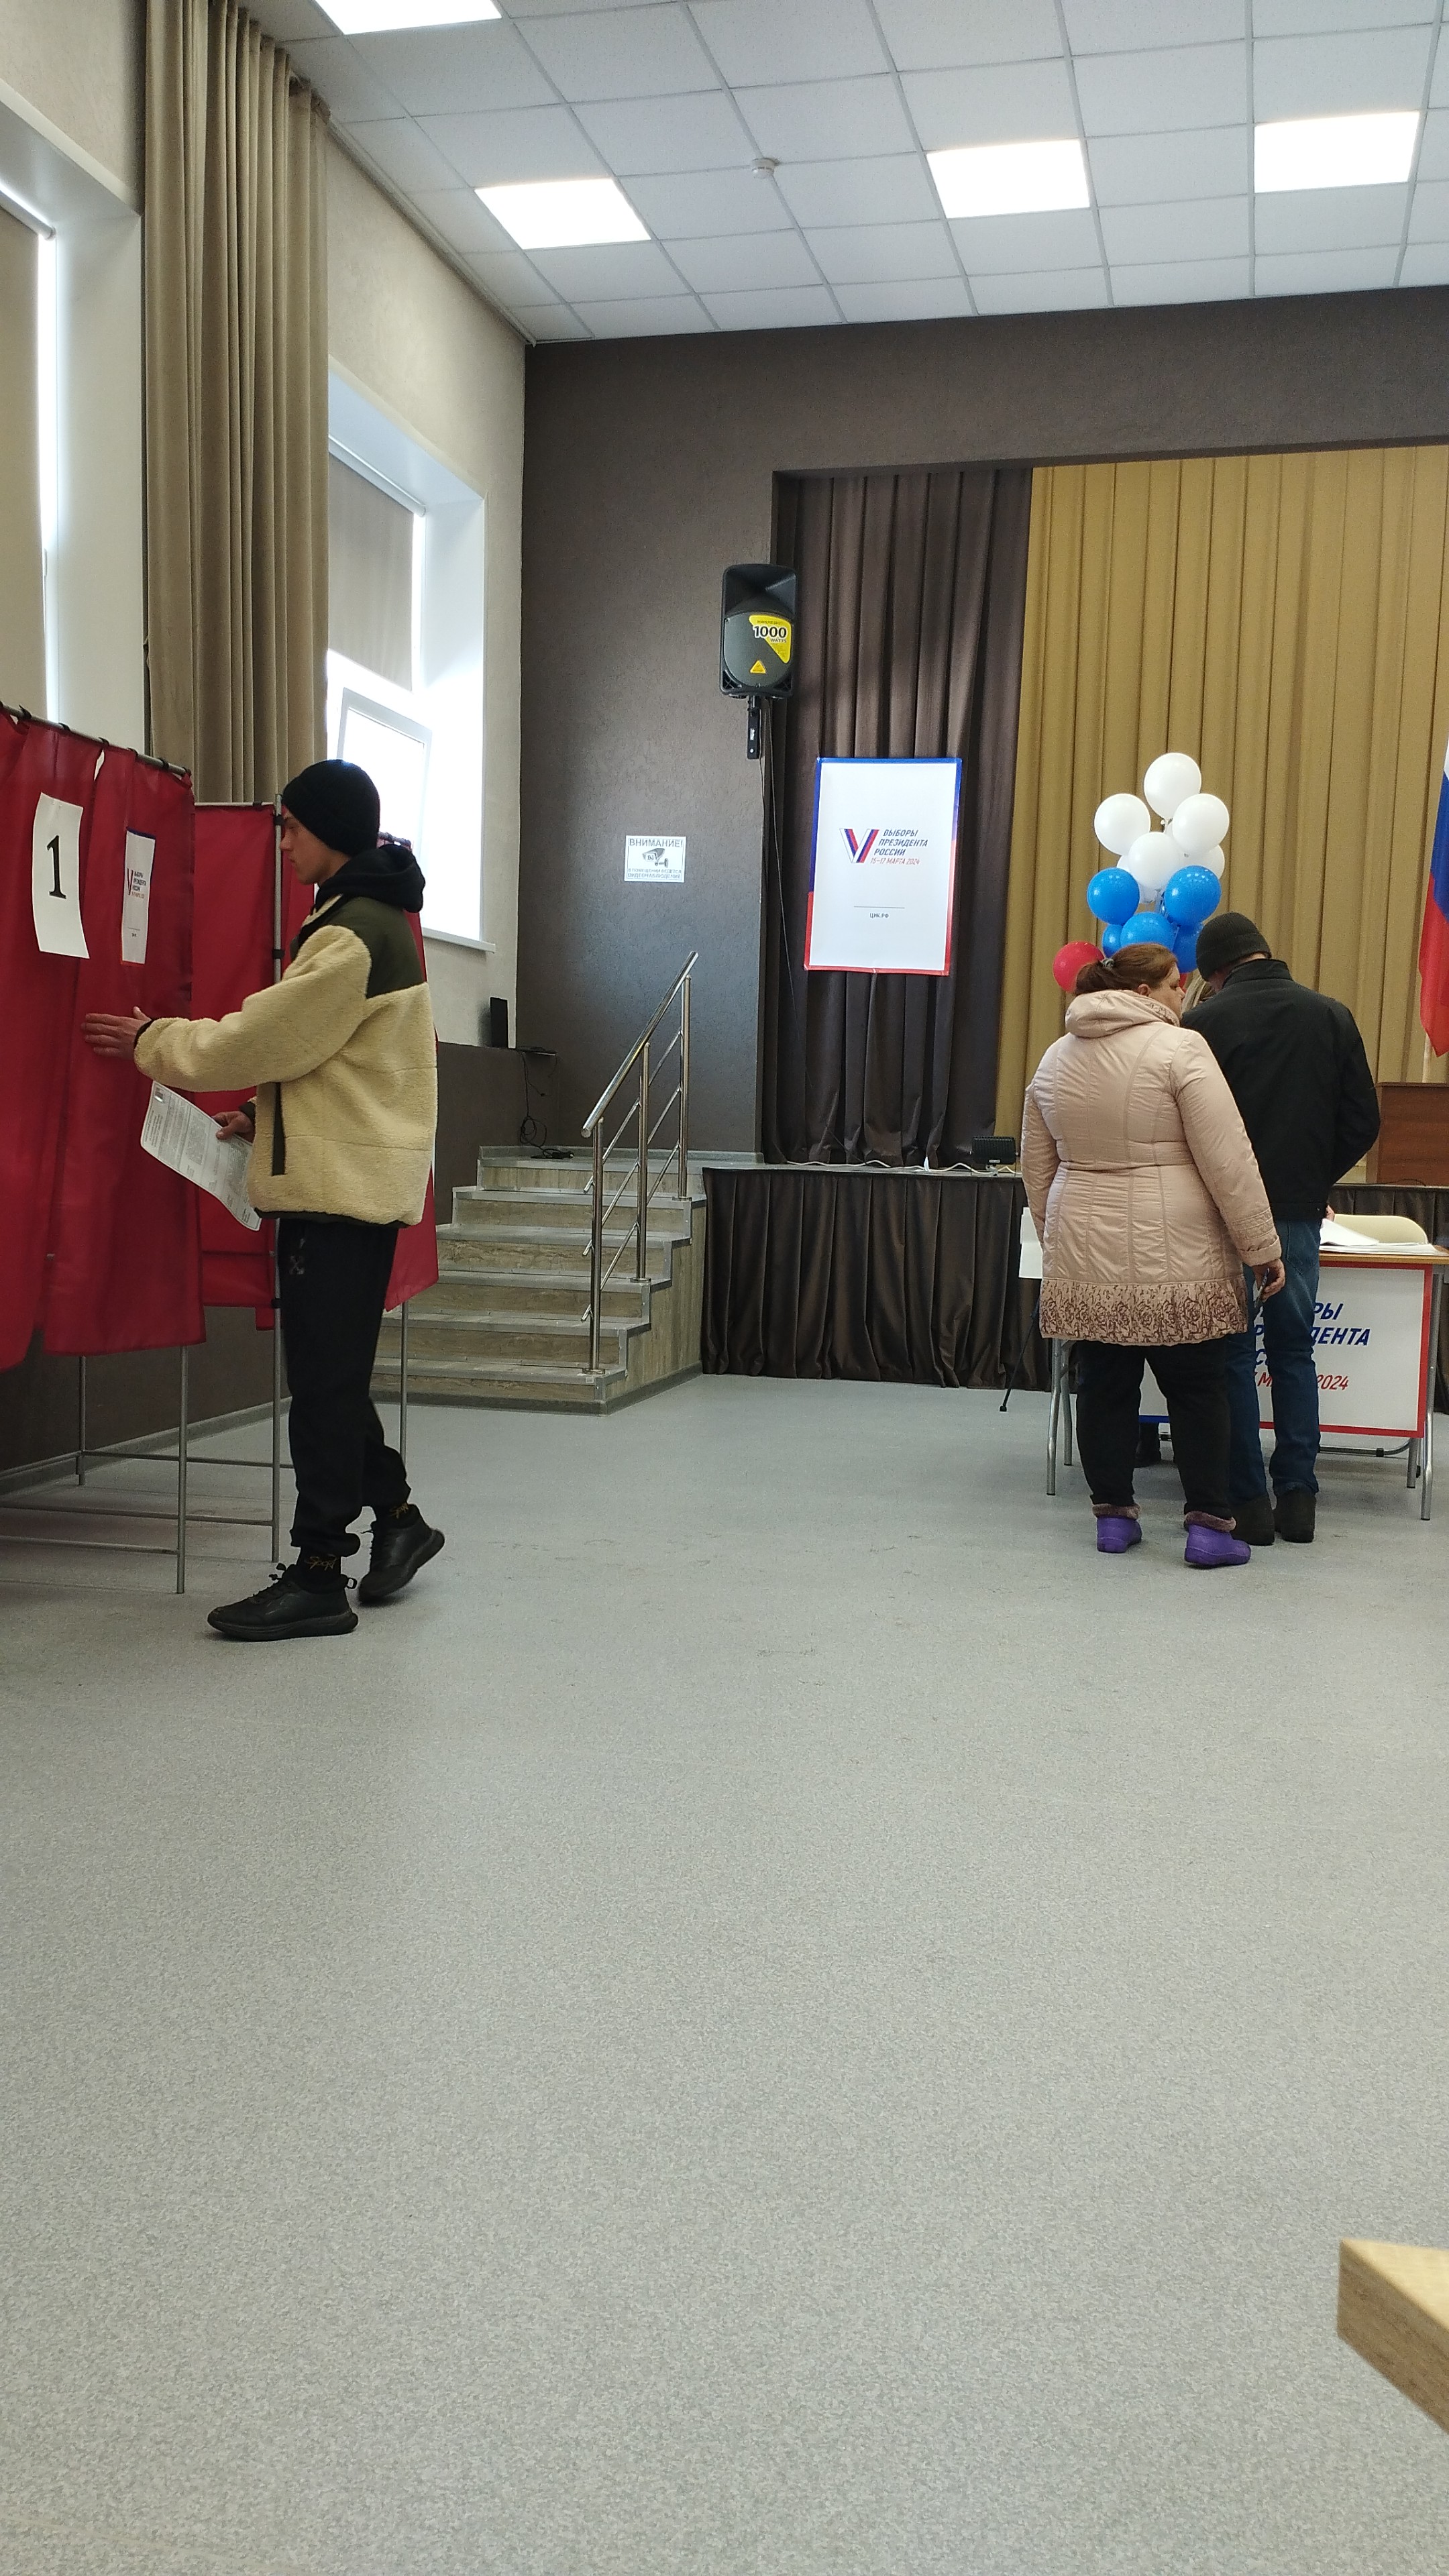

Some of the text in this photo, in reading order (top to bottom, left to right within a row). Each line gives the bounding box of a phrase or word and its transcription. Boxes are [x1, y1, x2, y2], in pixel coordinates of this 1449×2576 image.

[754, 626, 787, 638] 1000
[883, 829, 919, 837] ВЫБОРЫ
[629, 839, 683, 847] ВНИМАНИЕ!
[878, 839, 928, 847] ПРЕЗИДЕНТА
[873, 848, 906, 856] РОССИИ
[47, 835, 67, 900] 1
